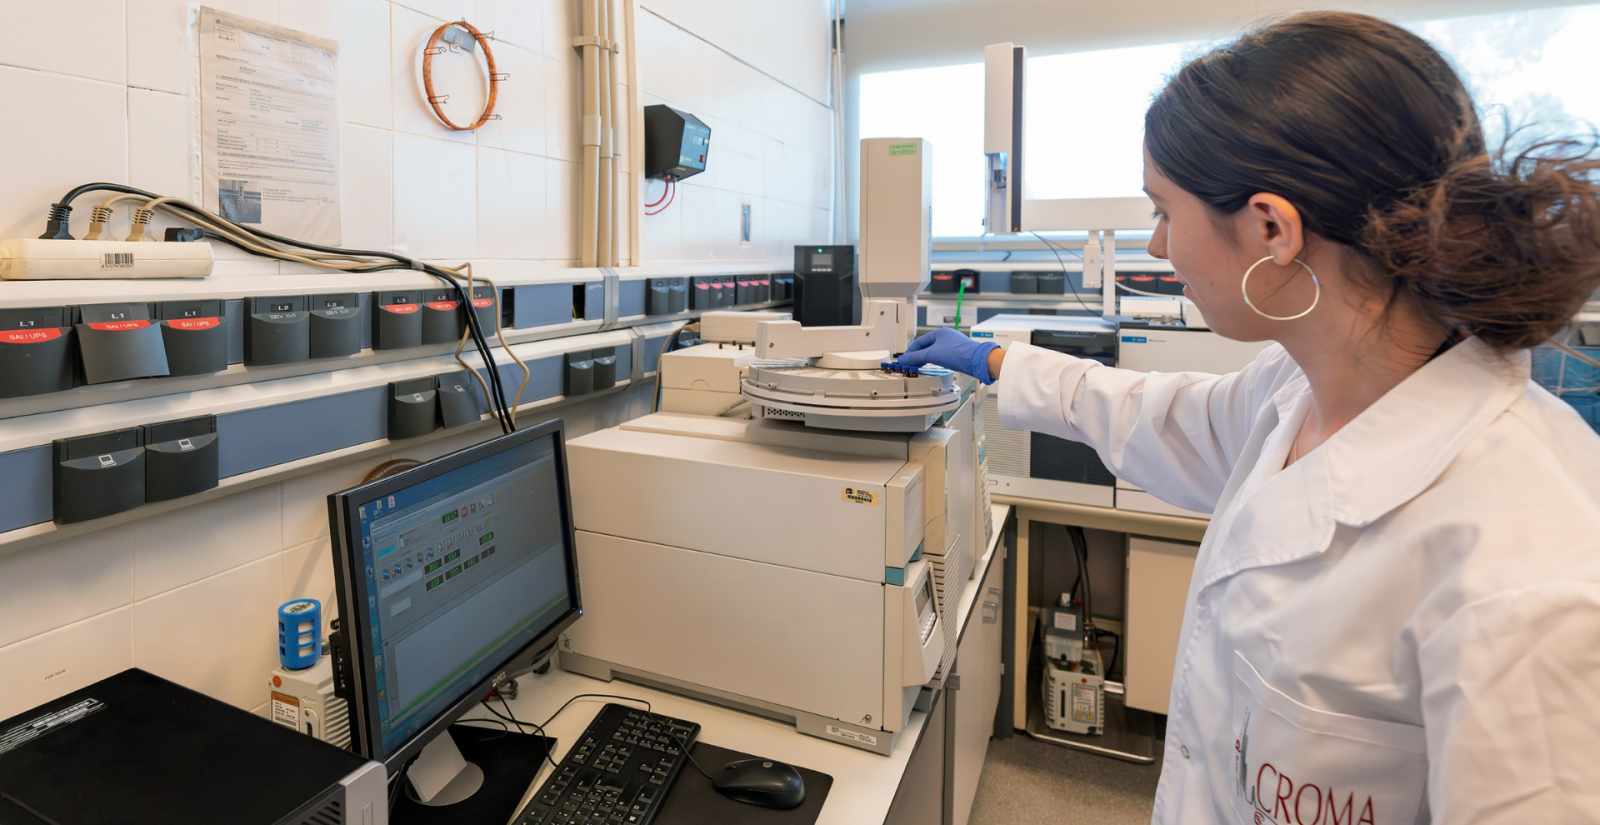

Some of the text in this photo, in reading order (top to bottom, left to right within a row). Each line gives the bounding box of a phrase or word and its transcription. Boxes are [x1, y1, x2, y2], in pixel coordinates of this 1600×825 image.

[9, 333, 24, 341] SAI
[29, 332, 48, 340] UPS
[1257, 763, 1375, 825] CROMA
